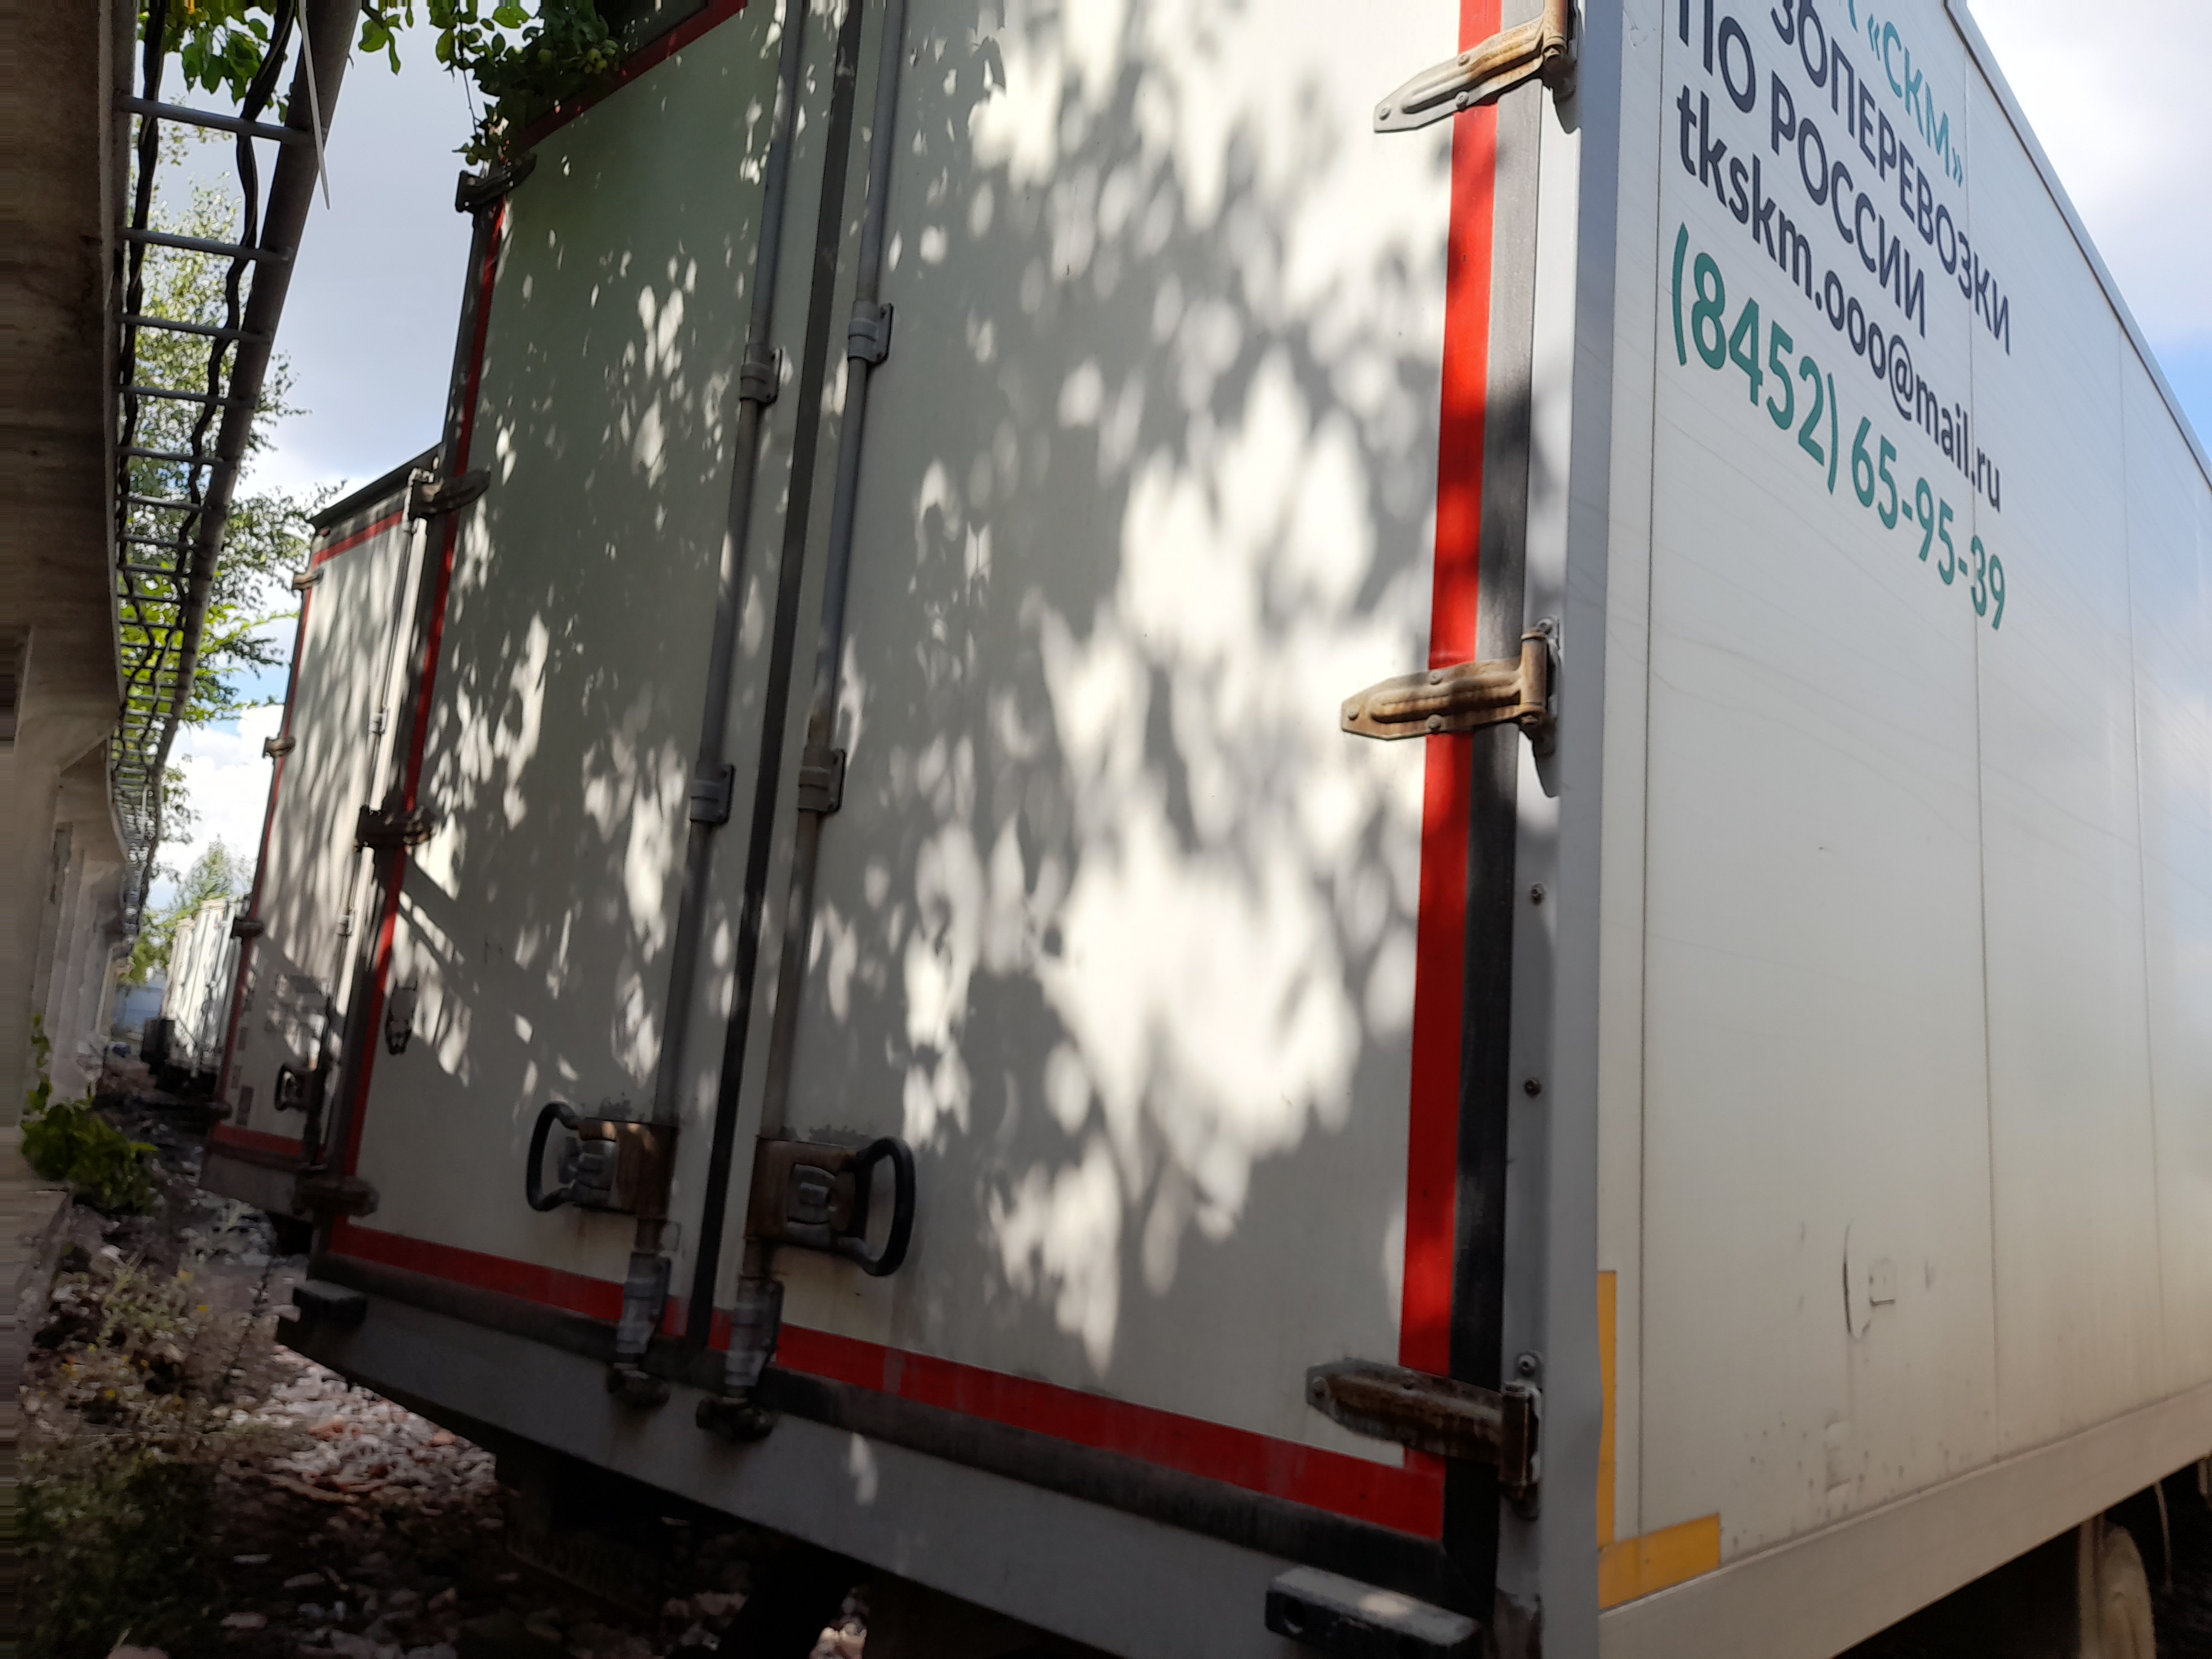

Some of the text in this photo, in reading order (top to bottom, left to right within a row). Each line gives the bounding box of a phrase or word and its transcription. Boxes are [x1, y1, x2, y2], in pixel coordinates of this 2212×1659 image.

[1677, 85, 2000, 513] tkskm.ooo@mail.ru
[1771, 70, 1926, 340] РОССИИ
[1672, 222, 2005, 631] (8452) 65-95-39
